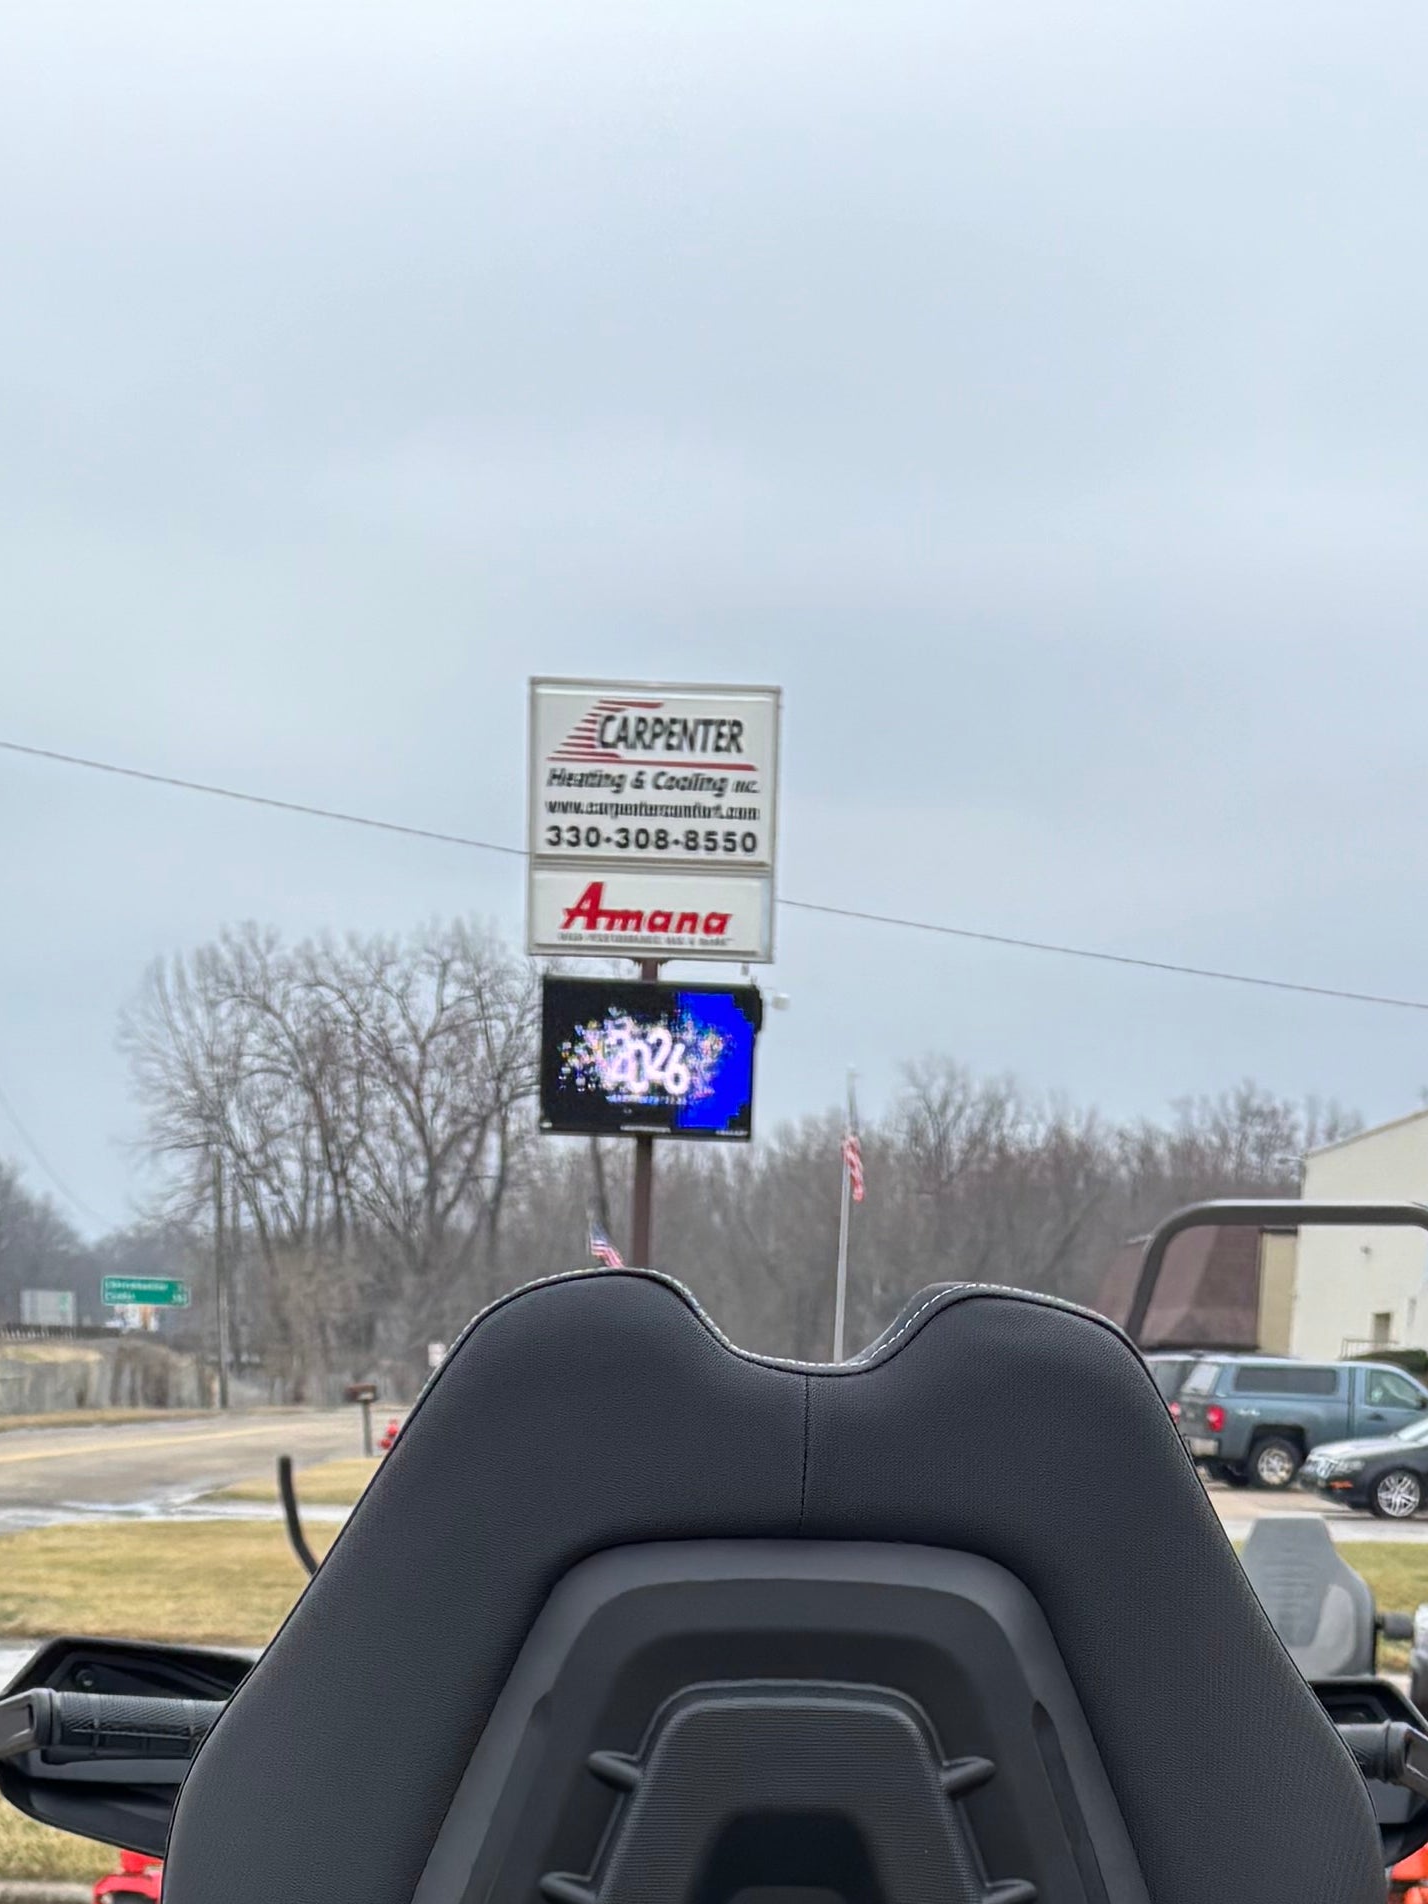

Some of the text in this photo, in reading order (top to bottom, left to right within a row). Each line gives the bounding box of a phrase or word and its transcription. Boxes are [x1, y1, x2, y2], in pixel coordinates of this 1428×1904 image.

[596, 714, 744, 753] CARPENTER
[546, 767, 627, 794] Heating
[630, 770, 646, 790] &
[652, 770, 728, 798] Cooling
[559, 881, 733, 935] Amana
